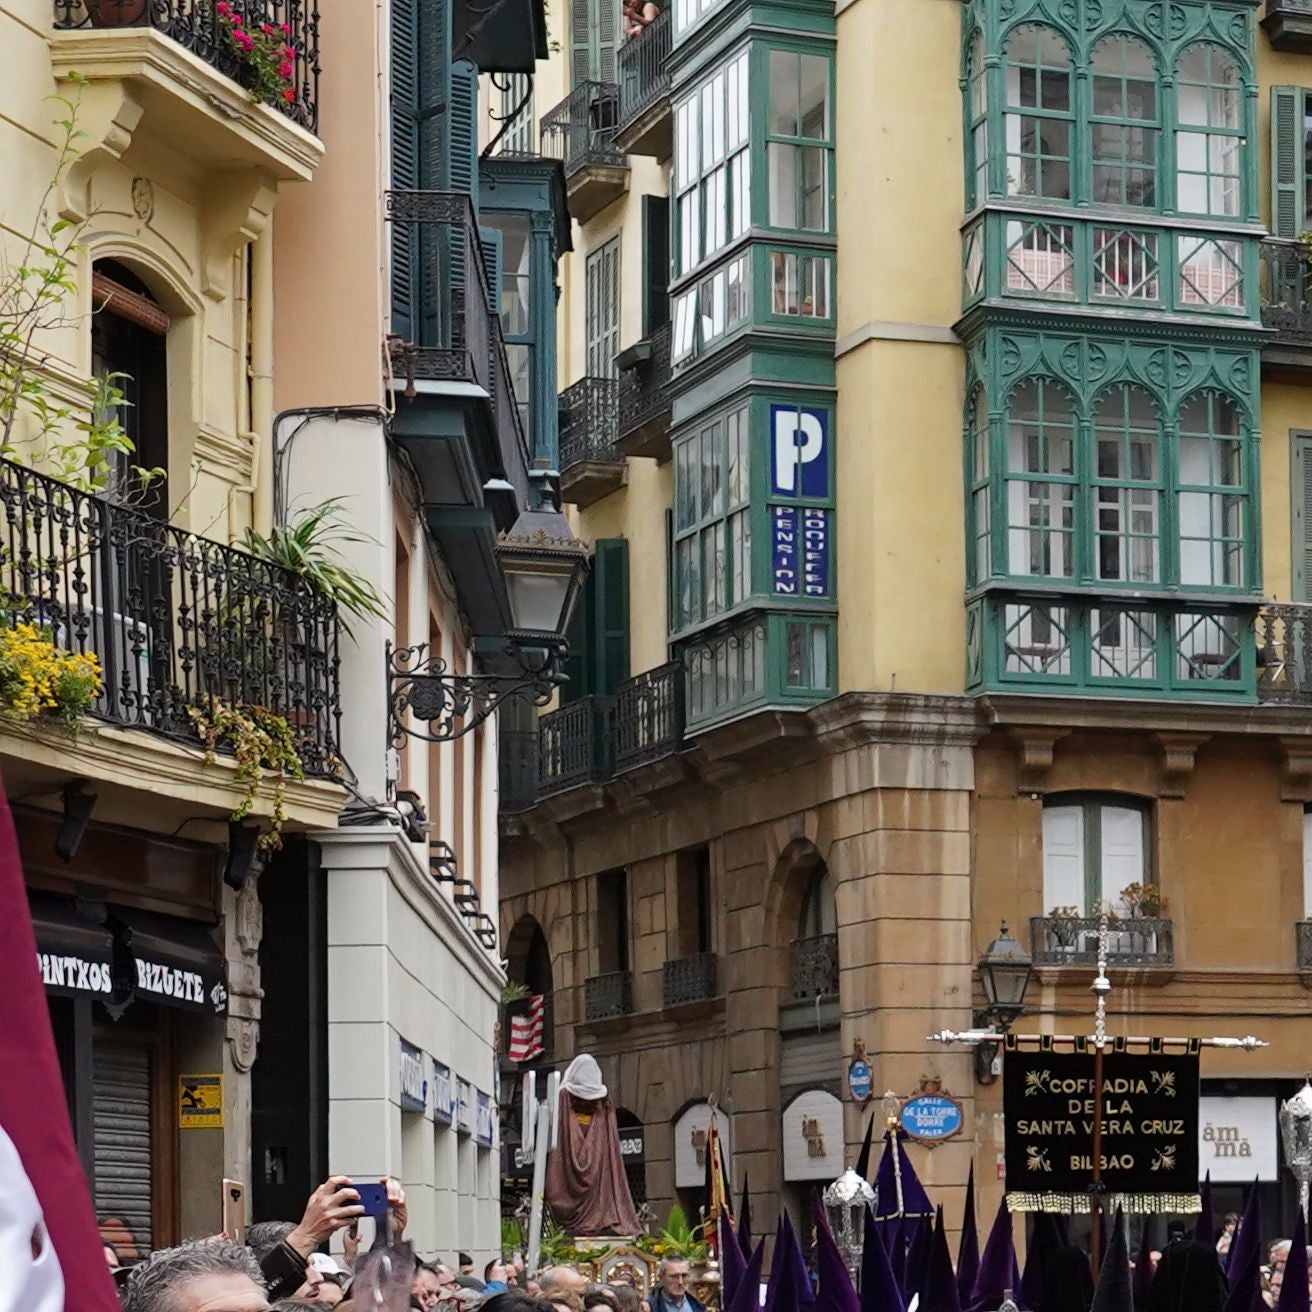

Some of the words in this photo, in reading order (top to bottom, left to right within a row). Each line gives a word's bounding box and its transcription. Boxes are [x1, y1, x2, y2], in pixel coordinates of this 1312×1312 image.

[776, 410, 823, 491] P
[1068, 1099, 1096, 1115] DE
[1105, 1099, 1134, 1115] LA
[1016, 1119, 1076, 1136] SANTA
[1082, 1119, 1135, 1136] VERA
[1140, 1119, 1185, 1136] CRUZ
[1069, 1153, 1135, 1171] BILBAO
